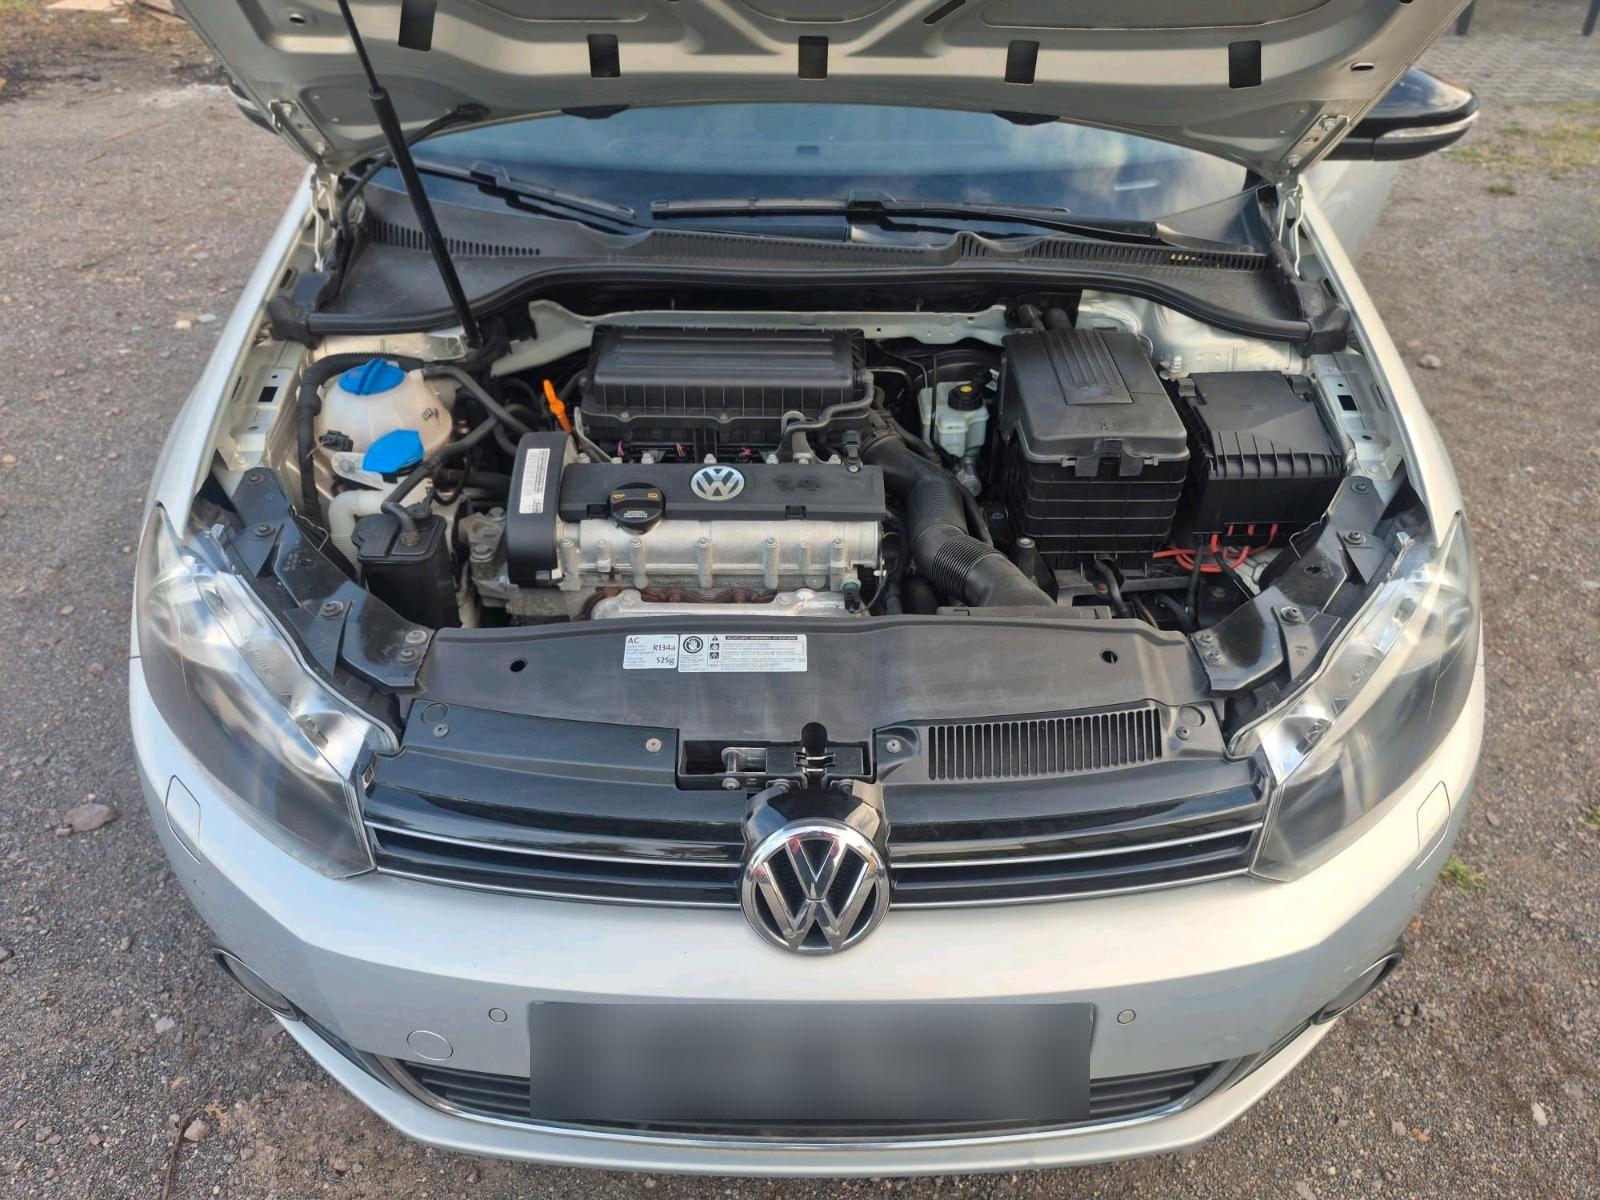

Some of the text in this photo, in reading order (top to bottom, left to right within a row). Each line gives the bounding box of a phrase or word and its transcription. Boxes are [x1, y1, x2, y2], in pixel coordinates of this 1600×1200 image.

[692, 466, 744, 500] VW
[656, 656, 675, 665] 525g
[745, 825, 886, 953] VW
